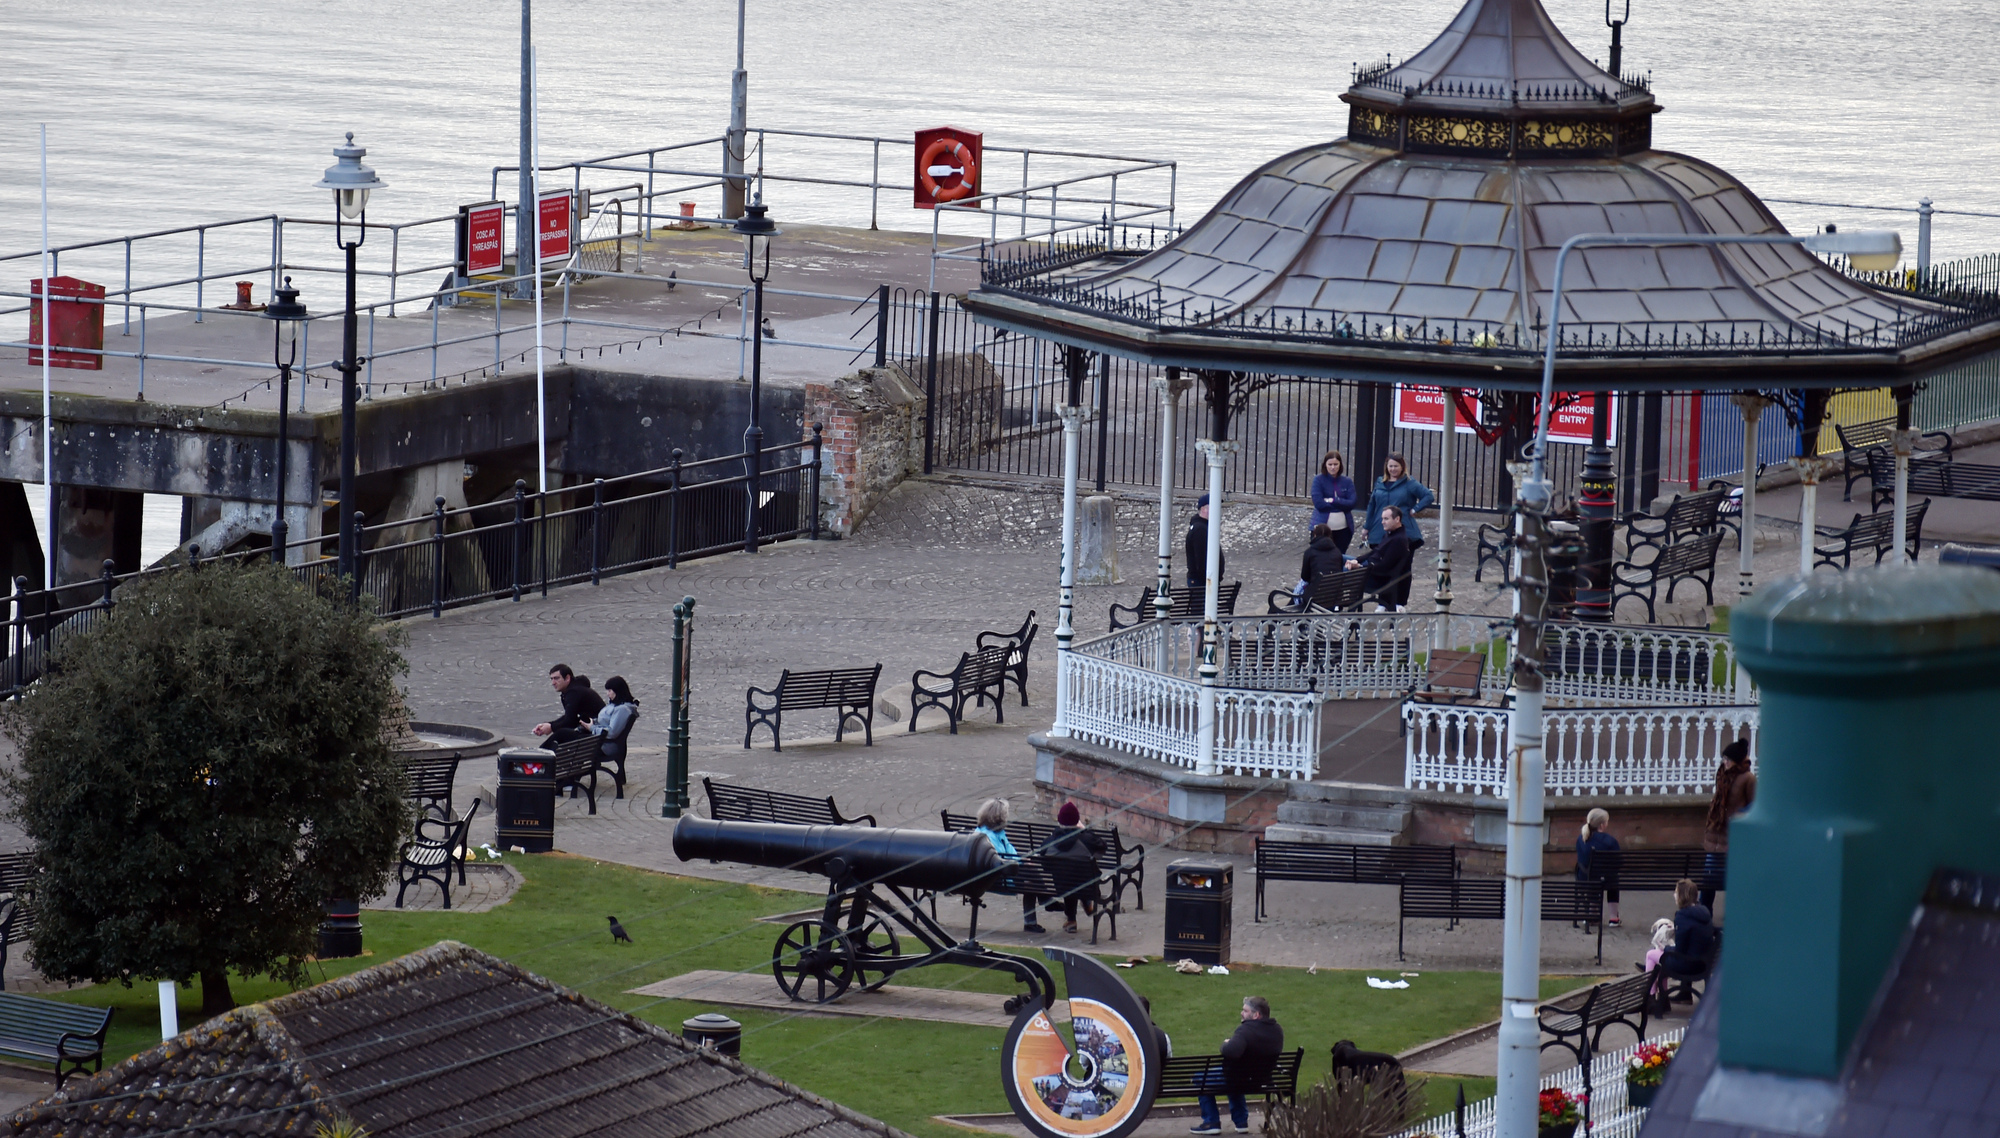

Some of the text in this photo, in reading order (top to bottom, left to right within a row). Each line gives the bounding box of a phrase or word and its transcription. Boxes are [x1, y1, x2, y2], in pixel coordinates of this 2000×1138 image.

[550, 219, 557, 228] NO
[476, 229, 495, 240] COSC AR
[1415, 395, 1432, 404] GAN
[1559, 414, 1587, 425] ENTRY
[1178, 932, 1205, 940] LITTER
